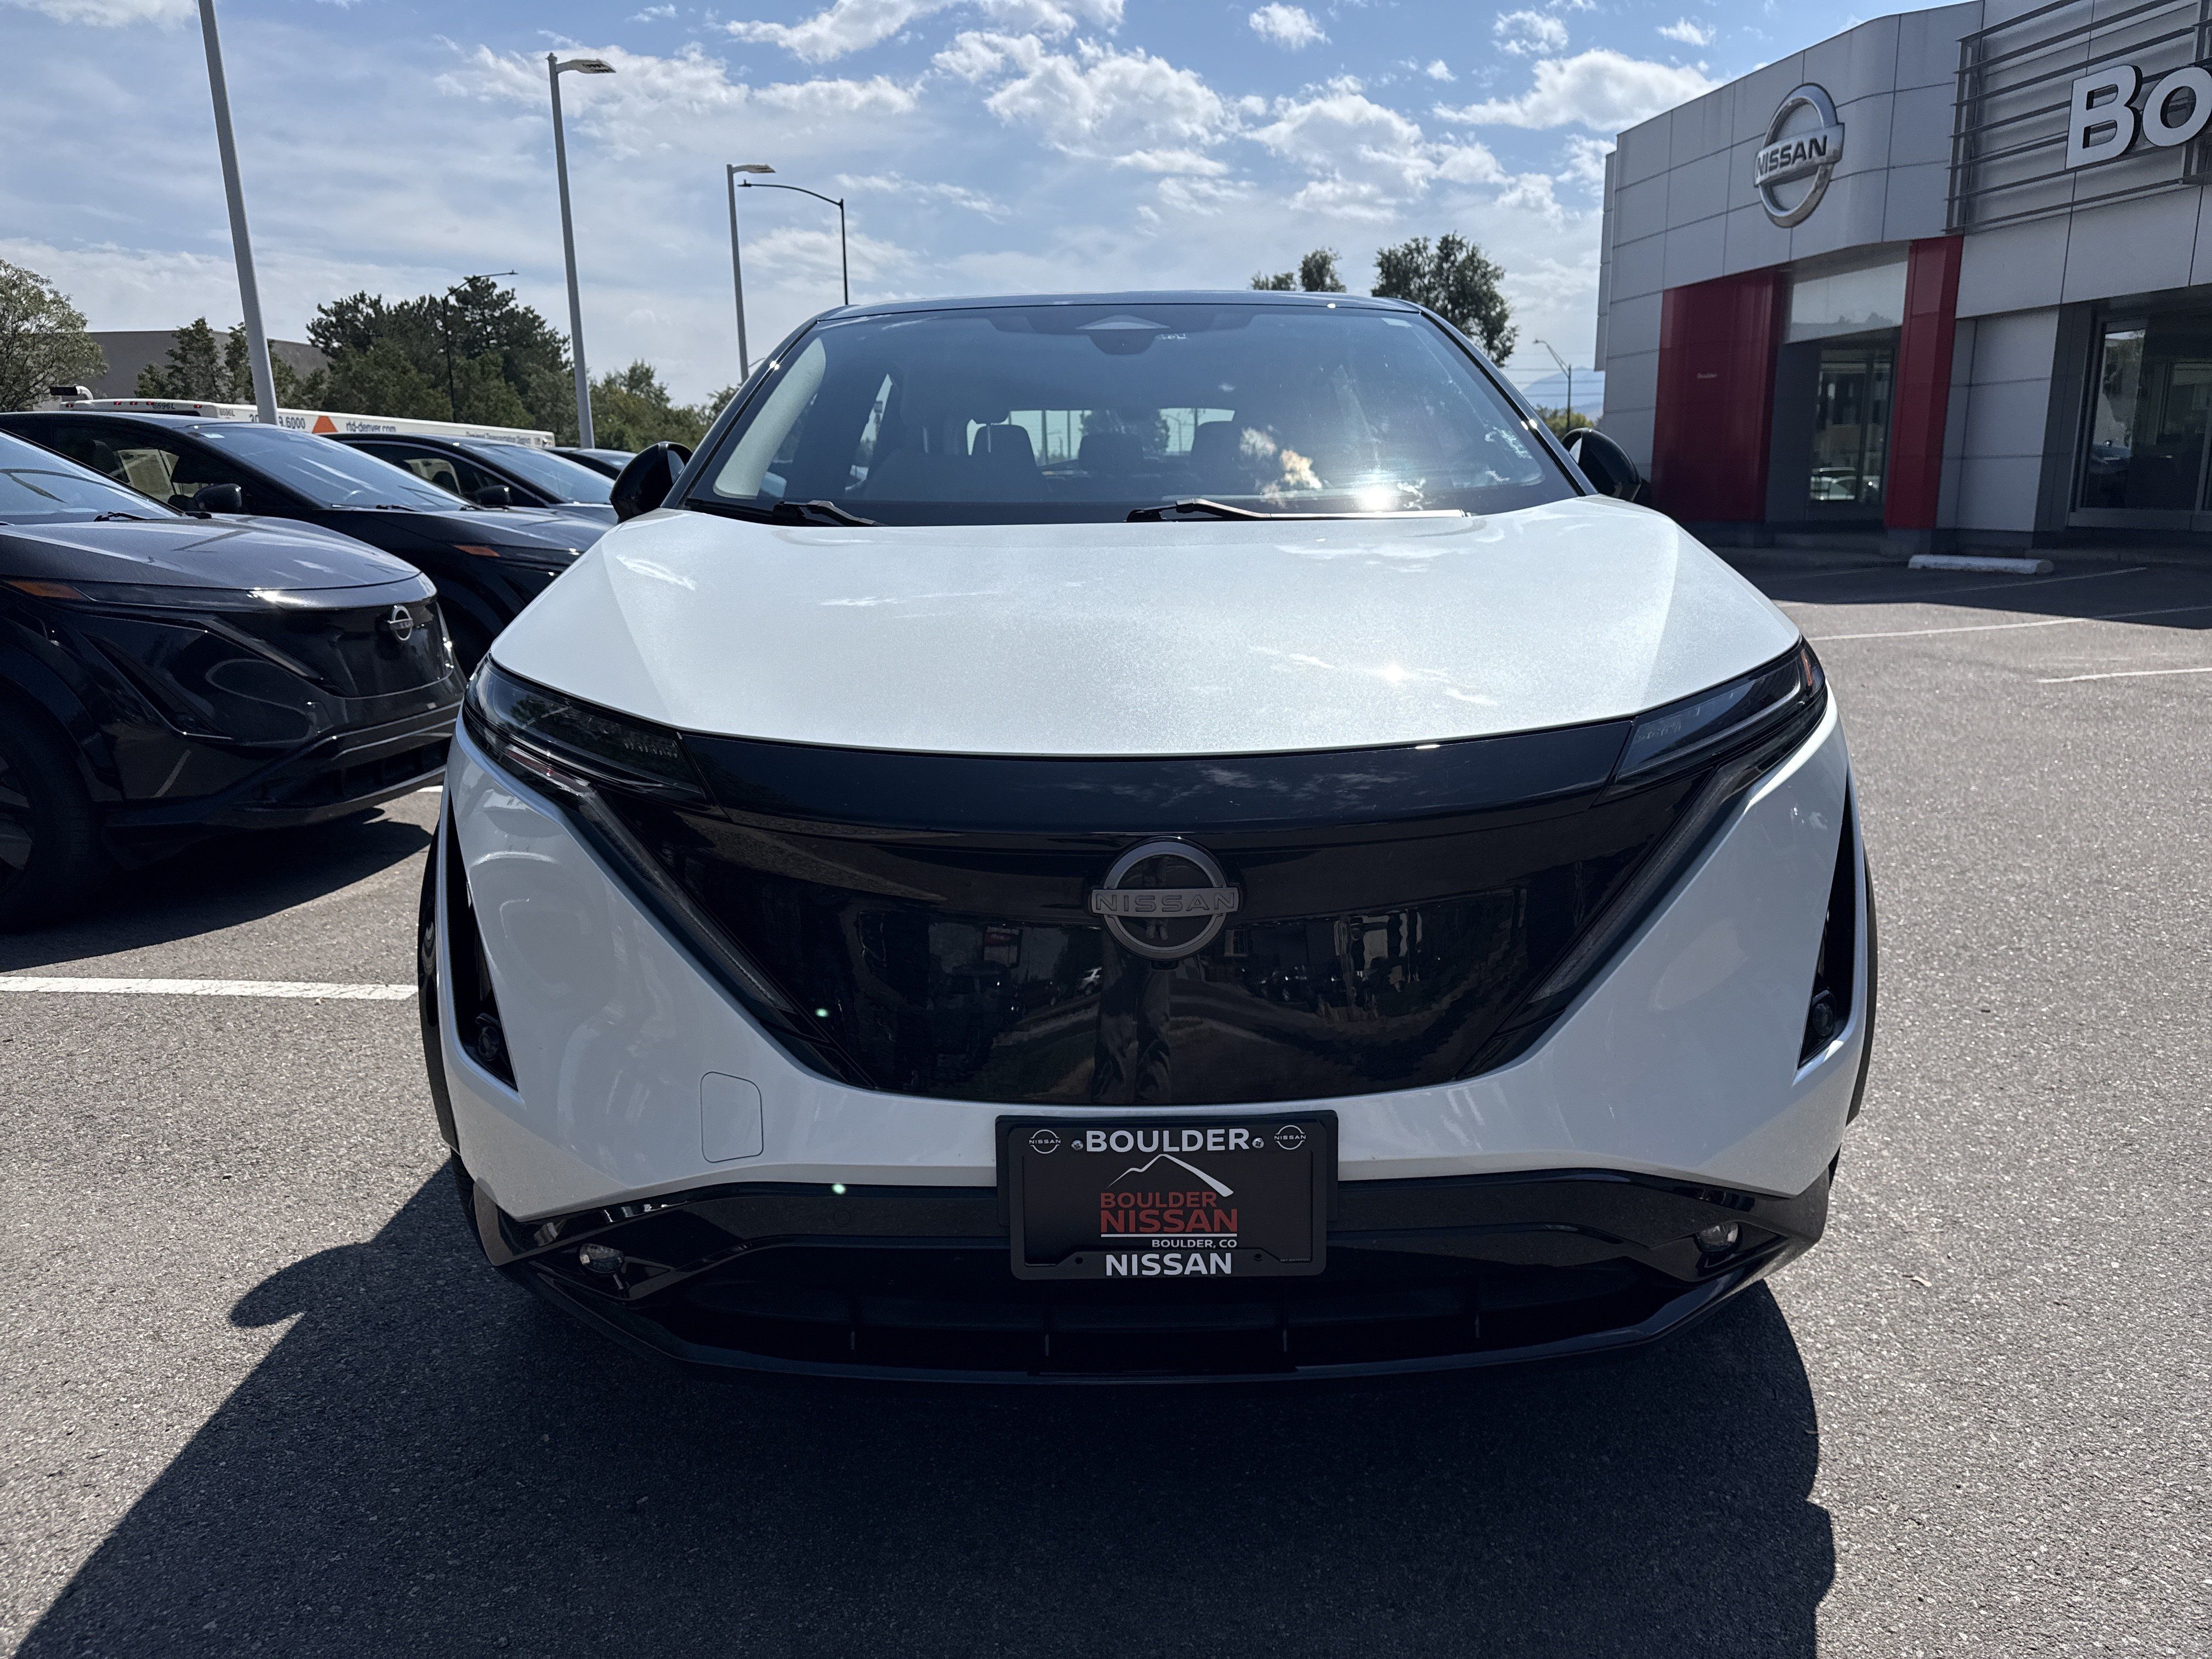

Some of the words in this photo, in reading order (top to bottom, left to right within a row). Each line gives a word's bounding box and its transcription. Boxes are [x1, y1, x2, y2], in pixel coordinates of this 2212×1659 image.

[1756, 134, 1827, 178] NISSAN
[1096, 892, 1235, 912] NISSAN
[1086, 1128, 1250, 1153] BOULDER
[1101, 1192, 1217, 1207] BOULDER
[1101, 1209, 1238, 1233] NISSAN
[1152, 1239, 1216, 1249] BOULDER,
[1218, 1239, 1238, 1248] CO
[1106, 1252, 1232, 1276] NISSAN
